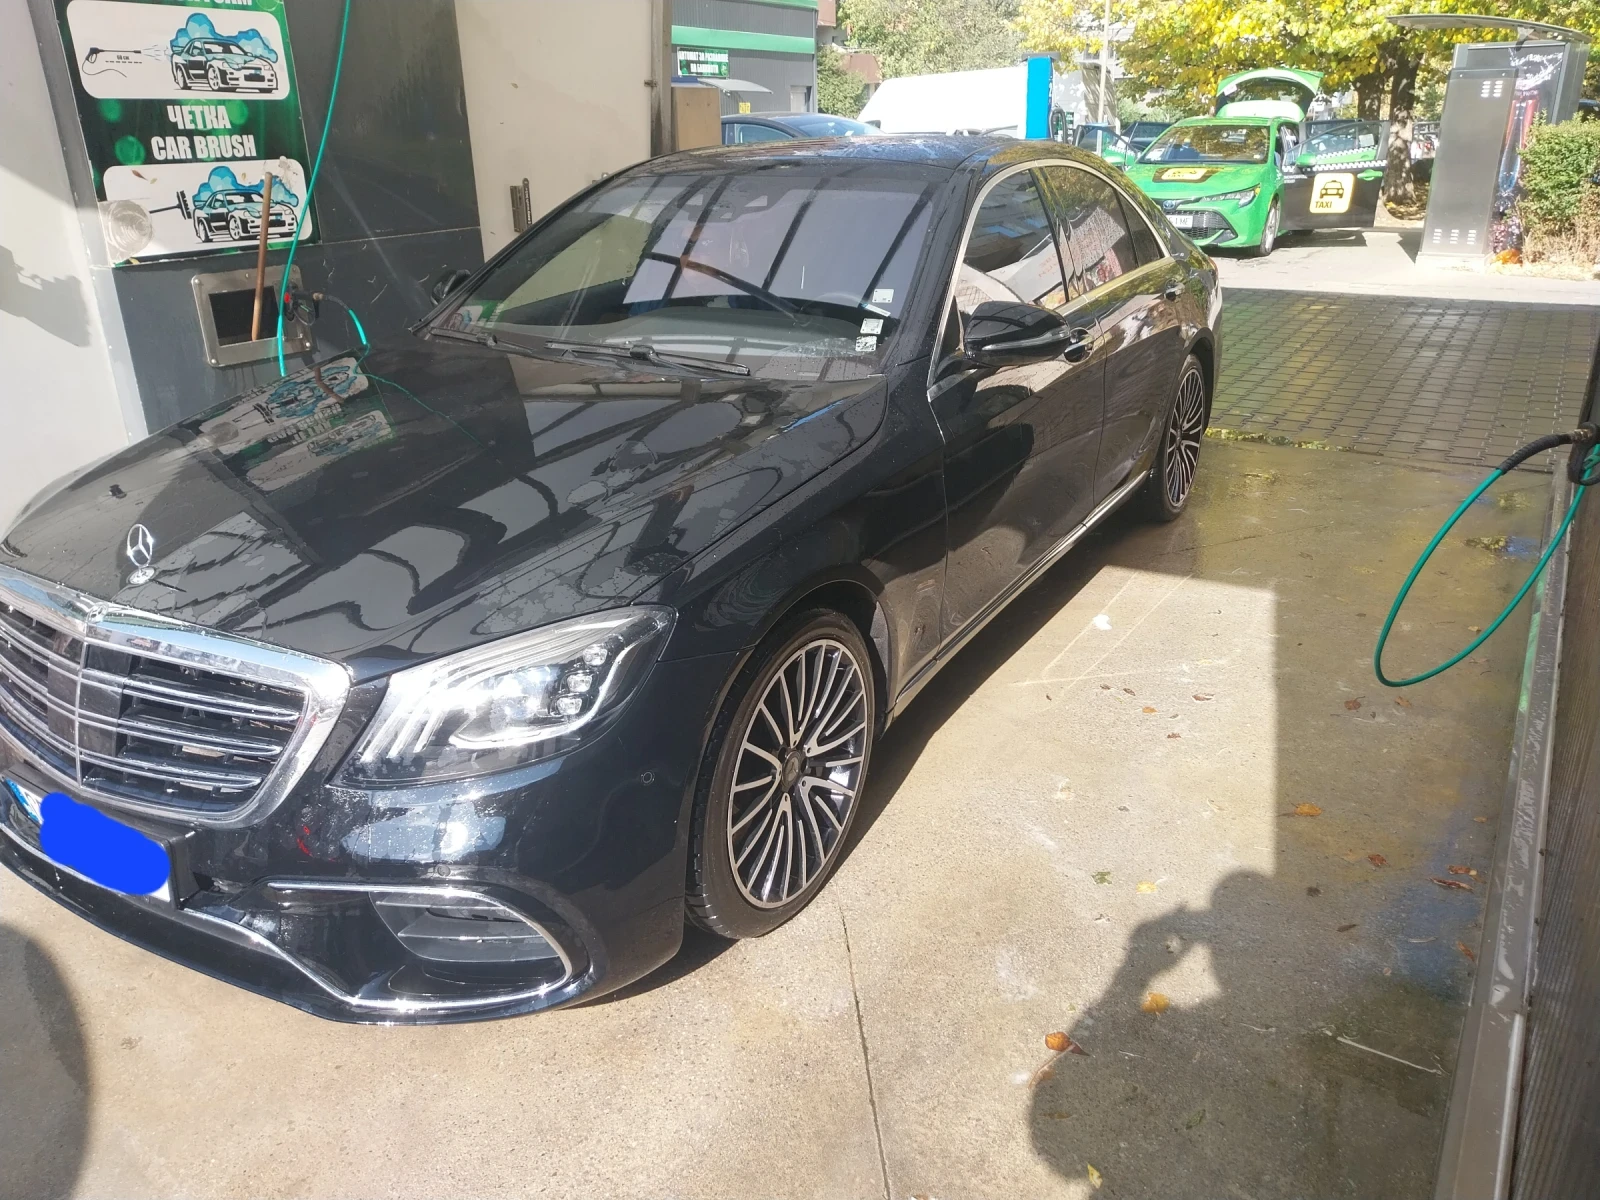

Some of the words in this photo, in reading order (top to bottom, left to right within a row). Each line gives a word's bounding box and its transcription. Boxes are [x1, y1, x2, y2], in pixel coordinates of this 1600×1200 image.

[166, 105, 232, 130] ЧЕТКА
[150, 135, 193, 161] CAR
[193, 134, 257, 159] BRUSH
[1315, 201, 1332, 209] TAXI
